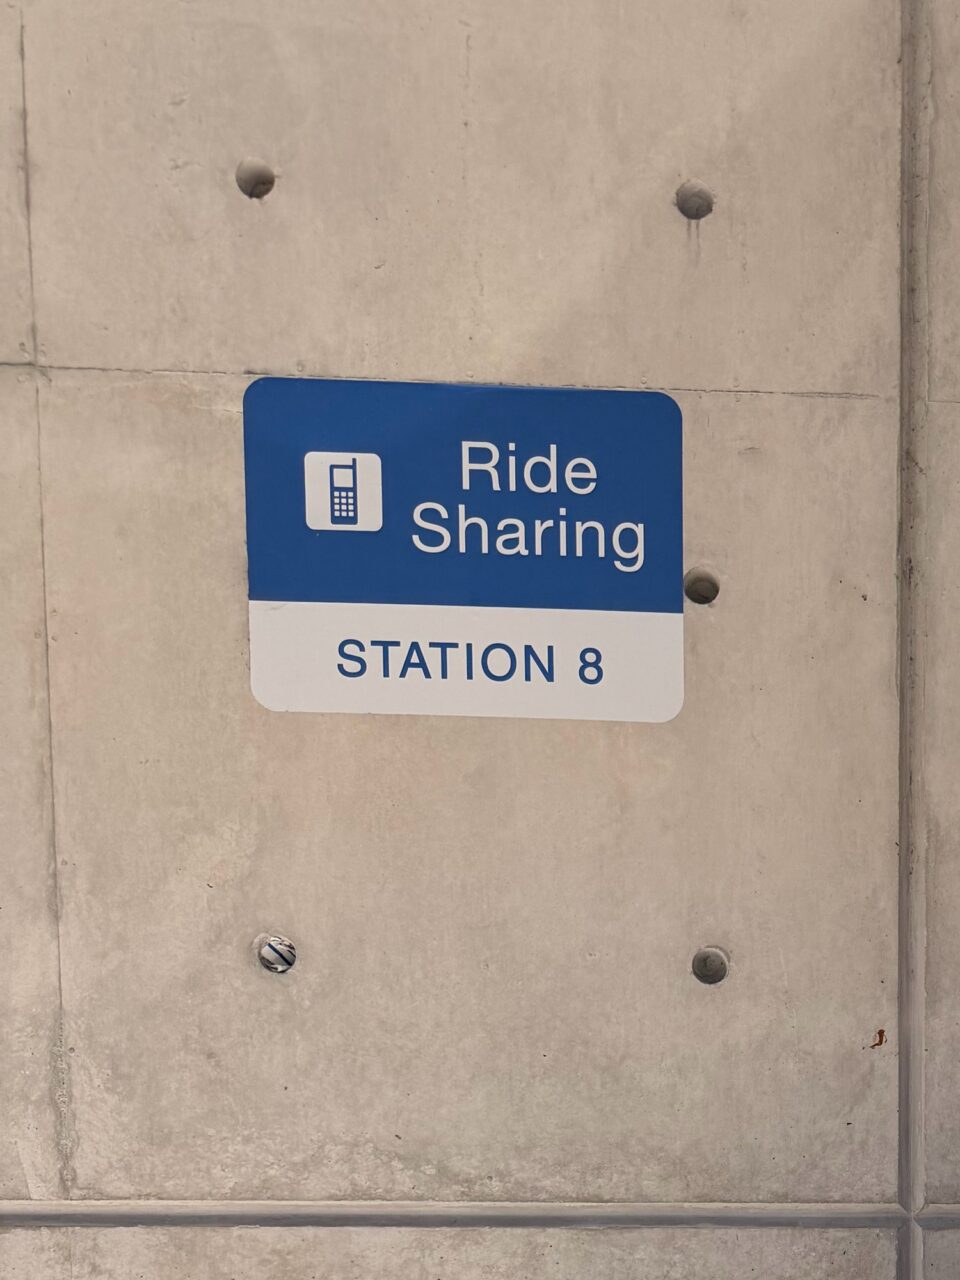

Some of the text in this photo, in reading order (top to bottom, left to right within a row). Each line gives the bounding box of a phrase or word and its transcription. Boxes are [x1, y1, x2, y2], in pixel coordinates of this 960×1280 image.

[462, 441, 596, 494] Ride
[412, 502, 644, 572] Sharing
[336, 638, 604, 685] STATION 8
